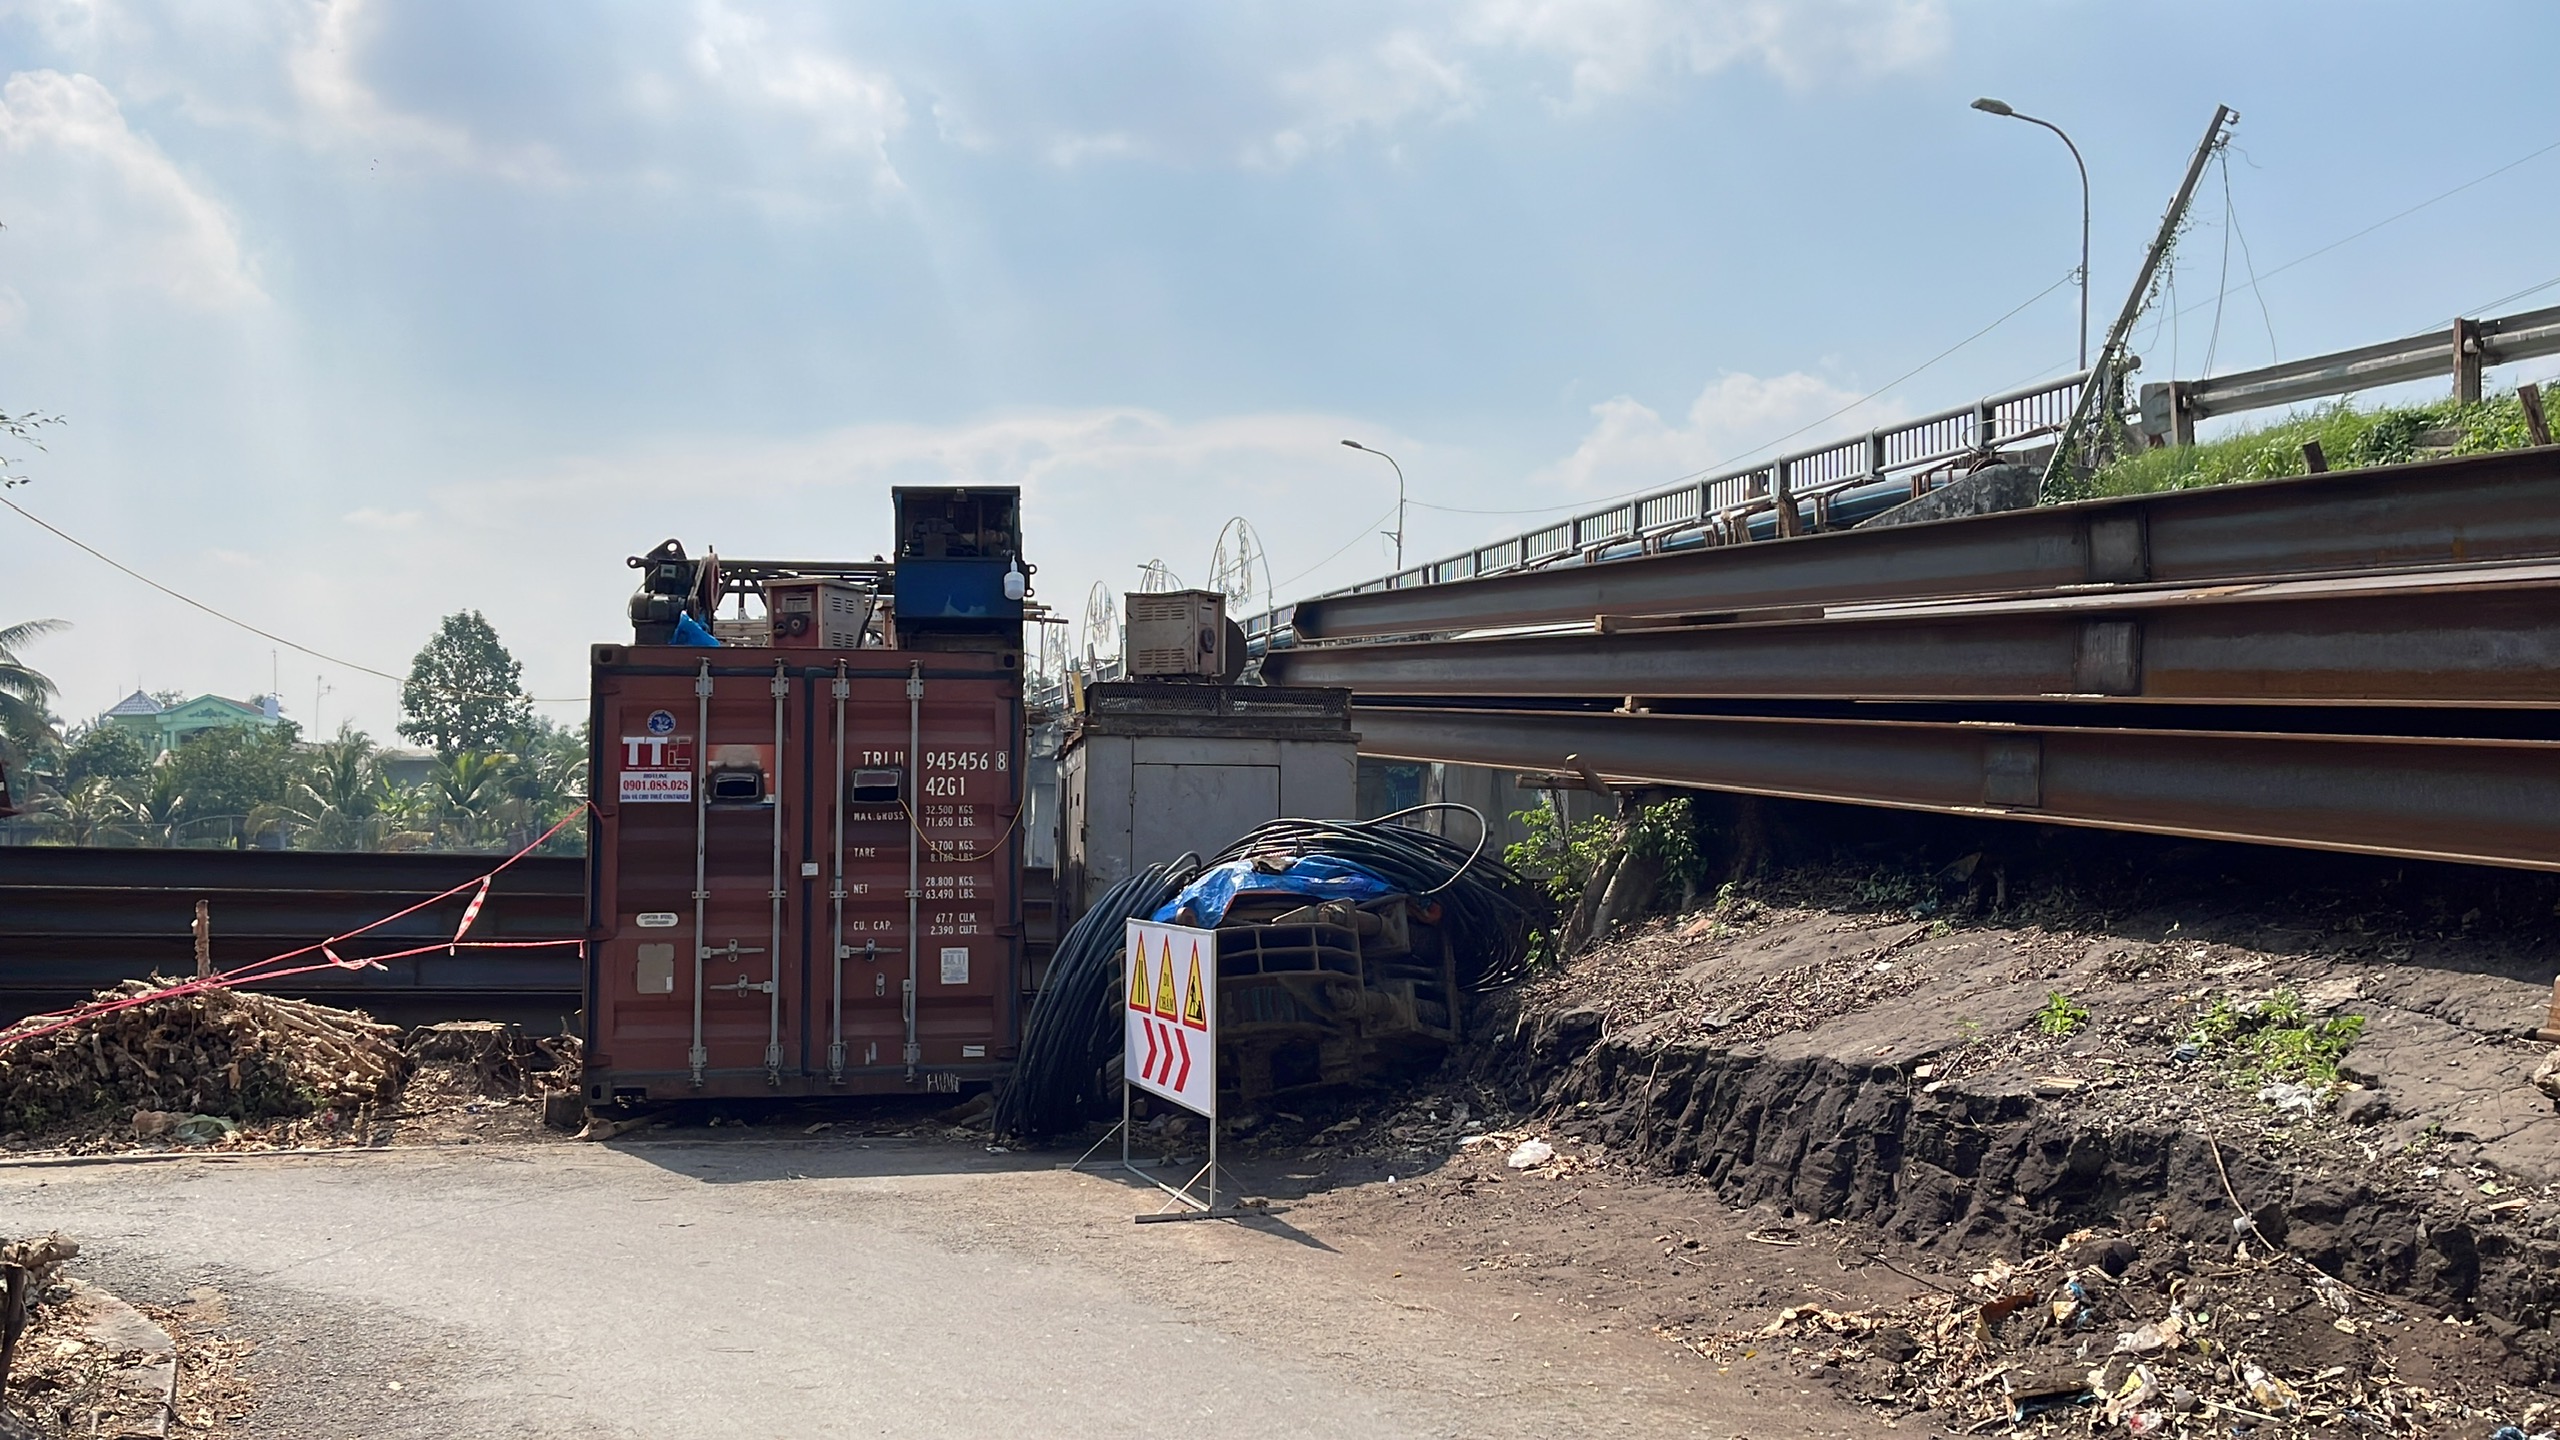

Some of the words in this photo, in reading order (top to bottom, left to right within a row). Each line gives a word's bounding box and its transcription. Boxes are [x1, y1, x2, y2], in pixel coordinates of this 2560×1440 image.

[926, 752, 989, 771] 945456
[996, 751, 1007, 771] 8
[925, 776, 966, 796] 42G1
[925, 805, 954, 815] 32.500
[925, 817, 954, 827] 71.650
[958, 817, 976, 827] LBS.
[930, 840, 954, 851] 3700
[958, 840, 977, 850] KGS.
[854, 848, 875, 858] TARE
[925, 876, 954, 887] 28.800
[958, 876, 977, 886] KGS.
[853, 884, 869, 894] NET
[925, 889, 954, 899] 63.490
[958, 889, 977, 899] LBS.
[935, 913, 954, 923] 67.7
[853, 921, 867, 931] CU.
[873, 920, 893, 931] CAP.
[930, 926, 954, 936] 2.390
